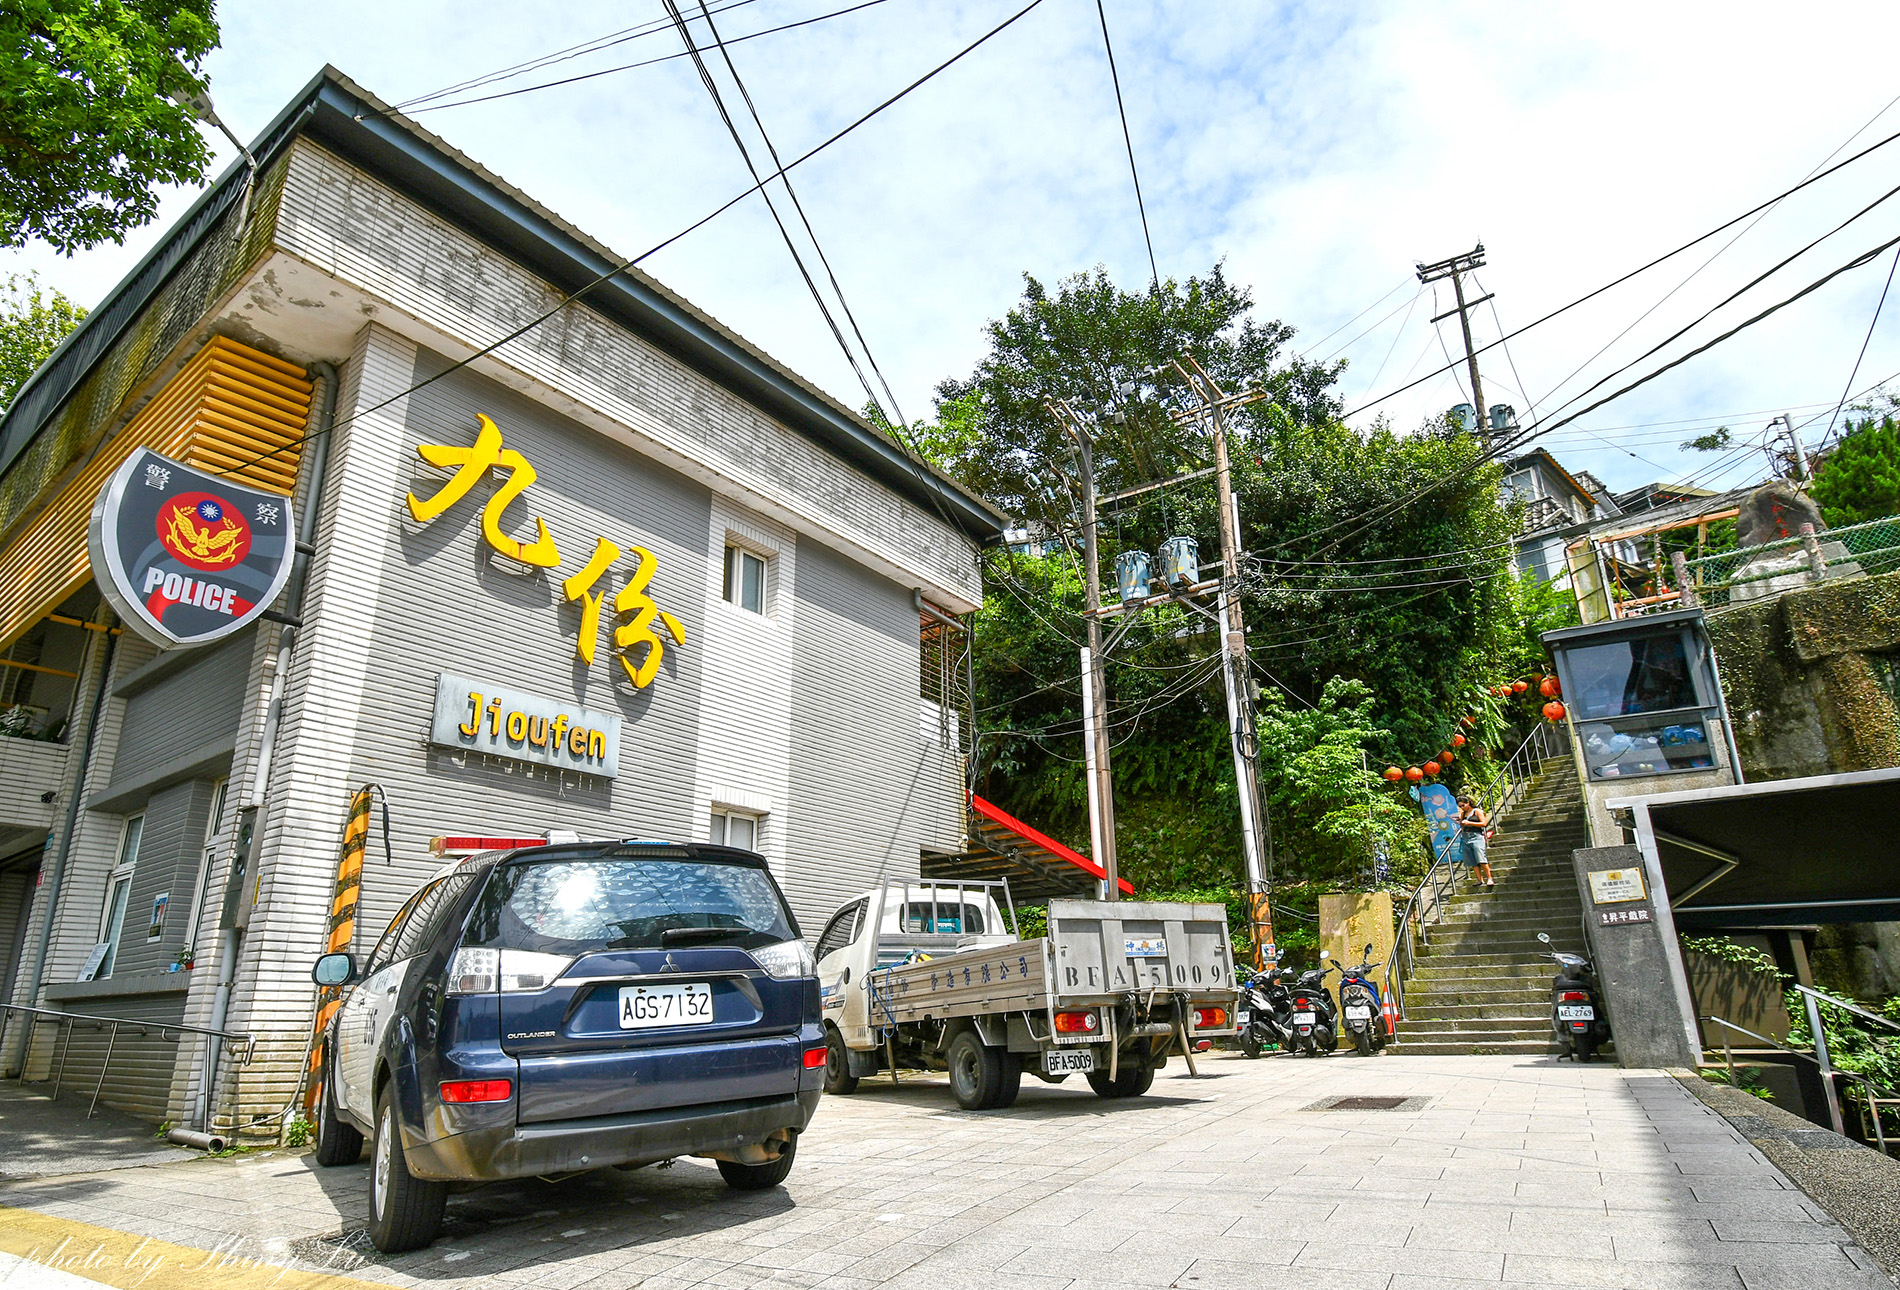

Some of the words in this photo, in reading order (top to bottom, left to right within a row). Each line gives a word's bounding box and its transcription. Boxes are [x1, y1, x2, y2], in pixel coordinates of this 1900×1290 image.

[143, 566, 237, 615] POLICE
[459, 691, 606, 759] Jioufen
[1065, 964, 1221, 987] BFA-5009
[507, 1030, 556, 1040] OUTLANDER
